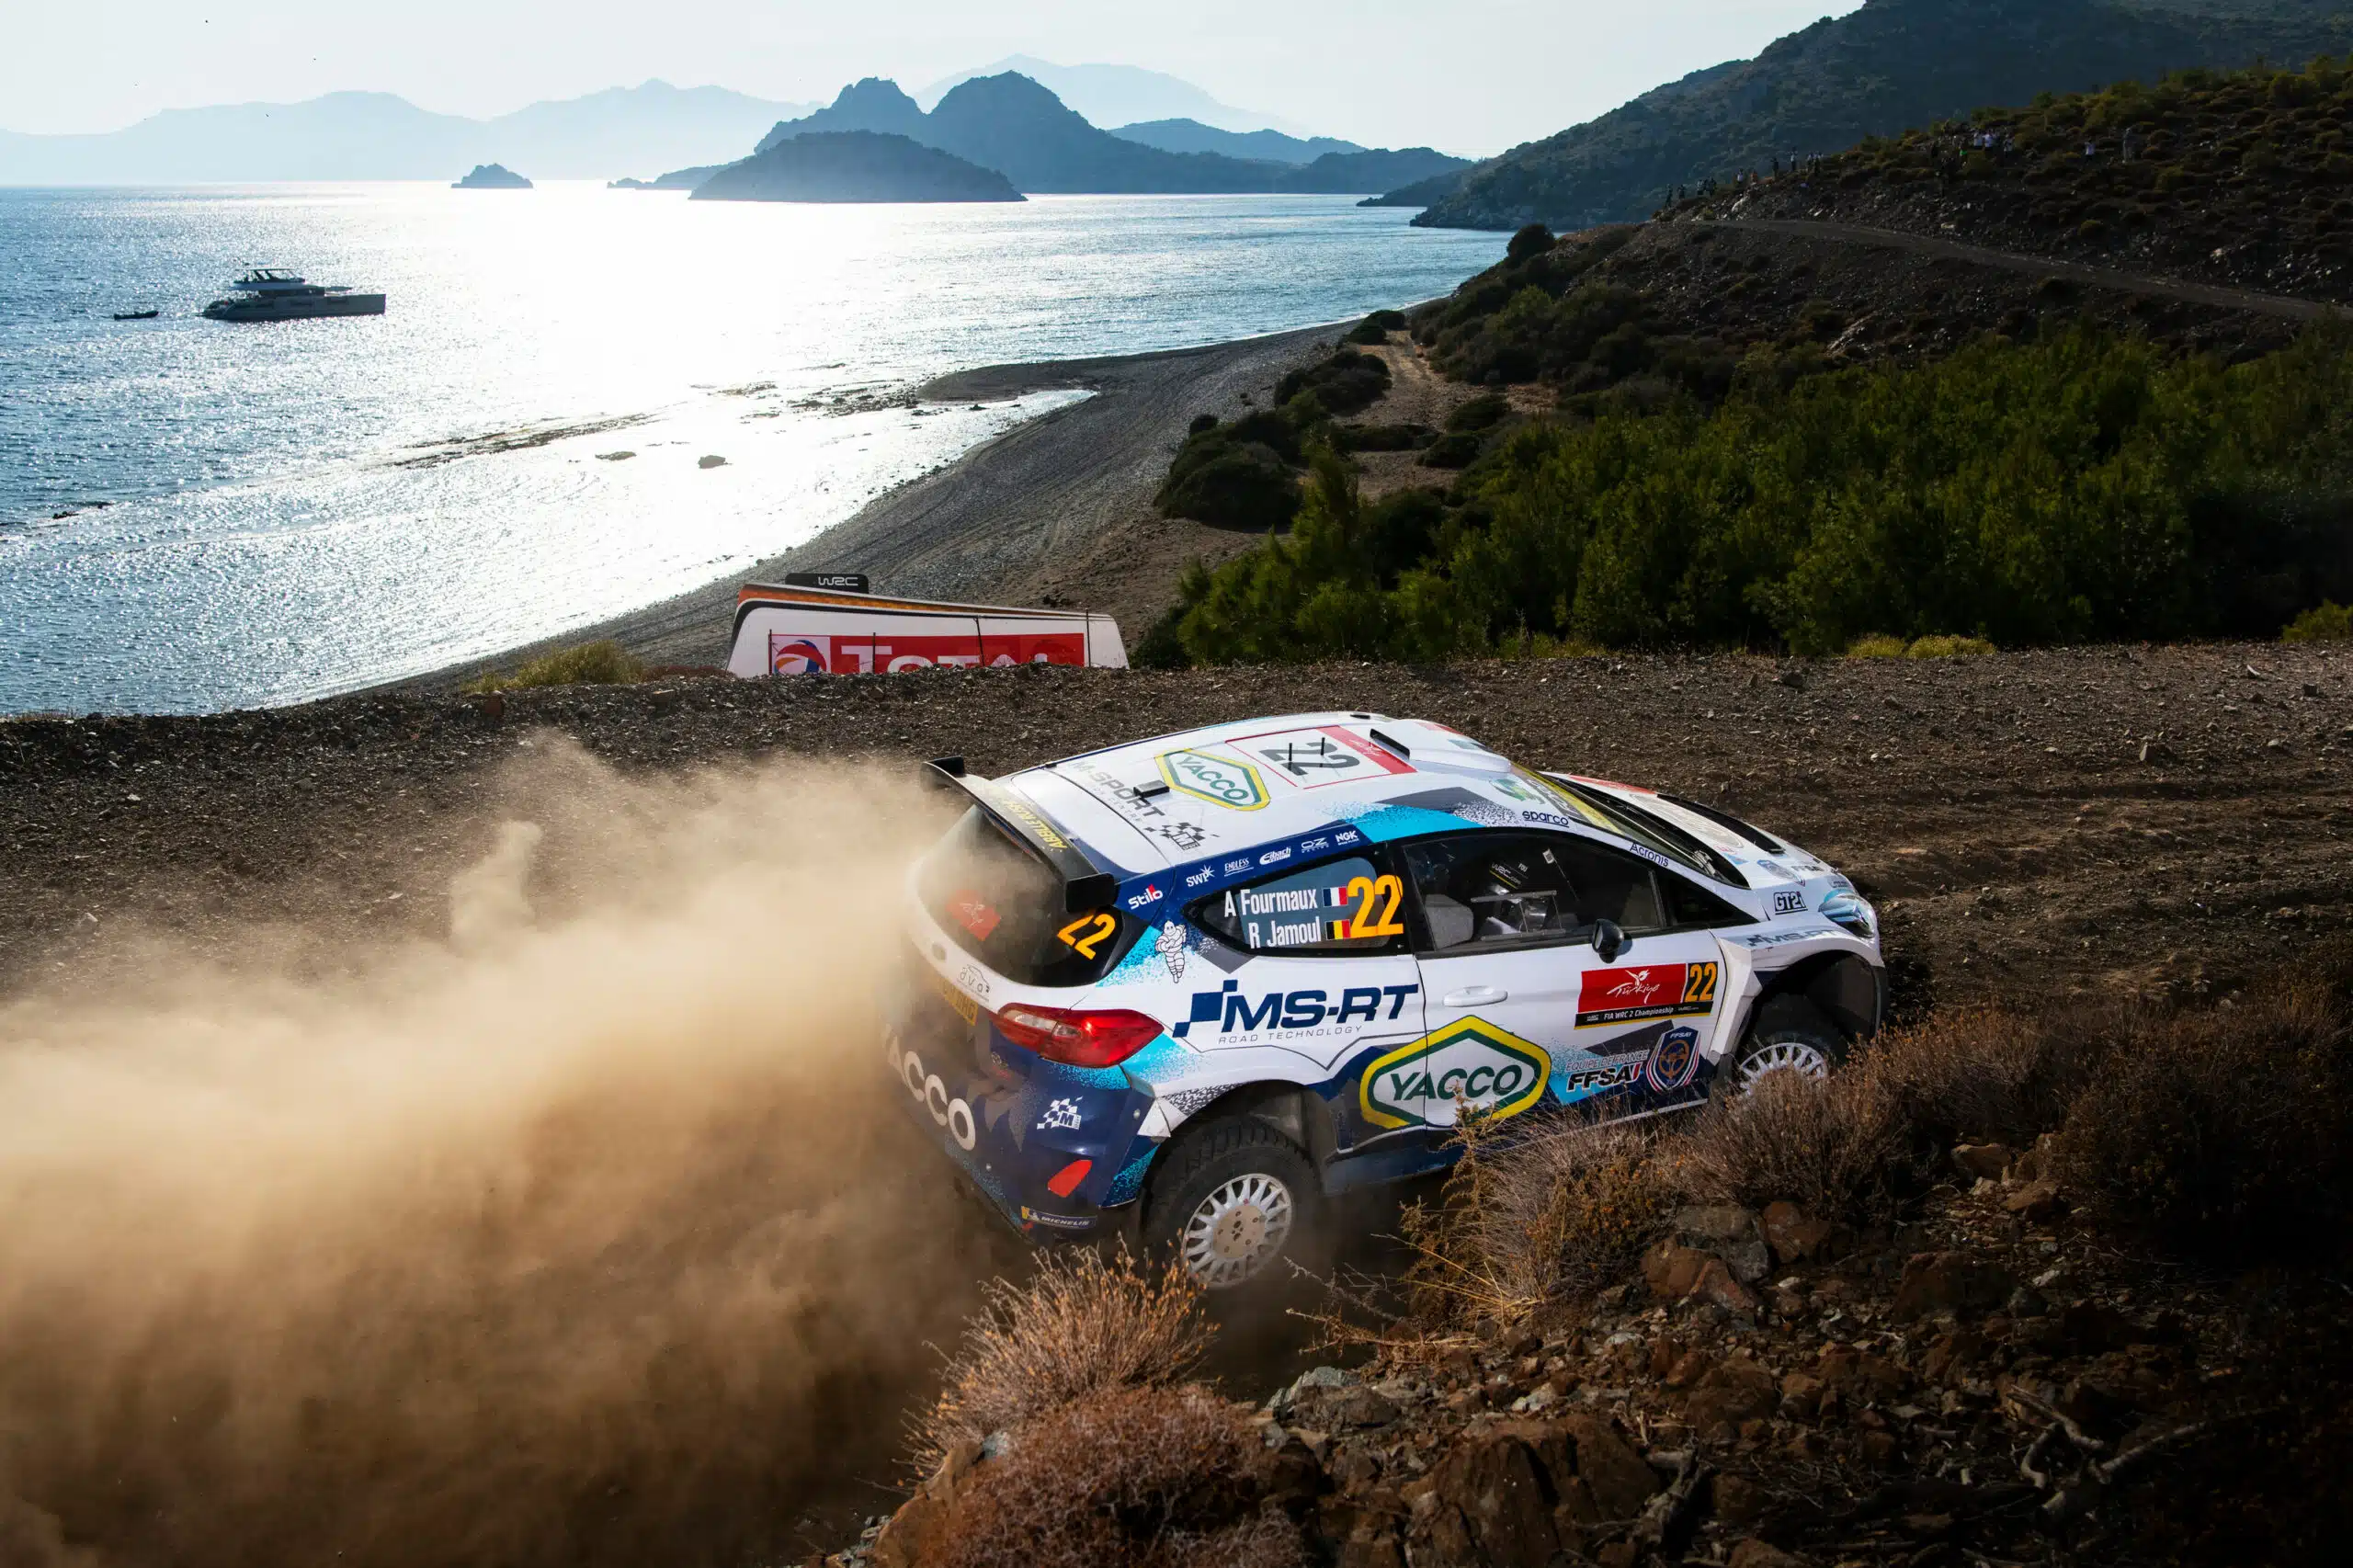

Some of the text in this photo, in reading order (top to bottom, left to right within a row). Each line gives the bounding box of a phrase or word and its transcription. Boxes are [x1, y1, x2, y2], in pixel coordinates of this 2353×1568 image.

[818, 576, 858, 586] WRC
[1258, 742, 1360, 776] 22
[1176, 756, 1249, 801] YACCO
[1522, 810, 1569, 826] sparco
[1302, 837, 1327, 849] OZ
[1336, 831, 1358, 843] NGK
[1224, 858, 1250, 872] ENDLESS
[1260, 846, 1290, 865] Eibach
[1630, 843, 1669, 867] Acronis
[1186, 868, 1213, 887] SWP
[1128, 884, 1164, 910] Stilo
[1224, 888, 1318, 917] A Fourmaux
[1347, 874, 1404, 938] 22
[1248, 916, 1322, 949] R Jamoul
[1685, 962, 1717, 1002] 22
[1222, 983, 1419, 1033] MS-RT
[1615, 1011, 1628, 1019] WRC
[1635, 1006, 1674, 1017] Championship
[1218, 1025, 1362, 1044] ROAD TECHNOLOGY
[1390, 1064, 1522, 1101] YACCO
[1040, 1216, 1090, 1226] MICHELIN
